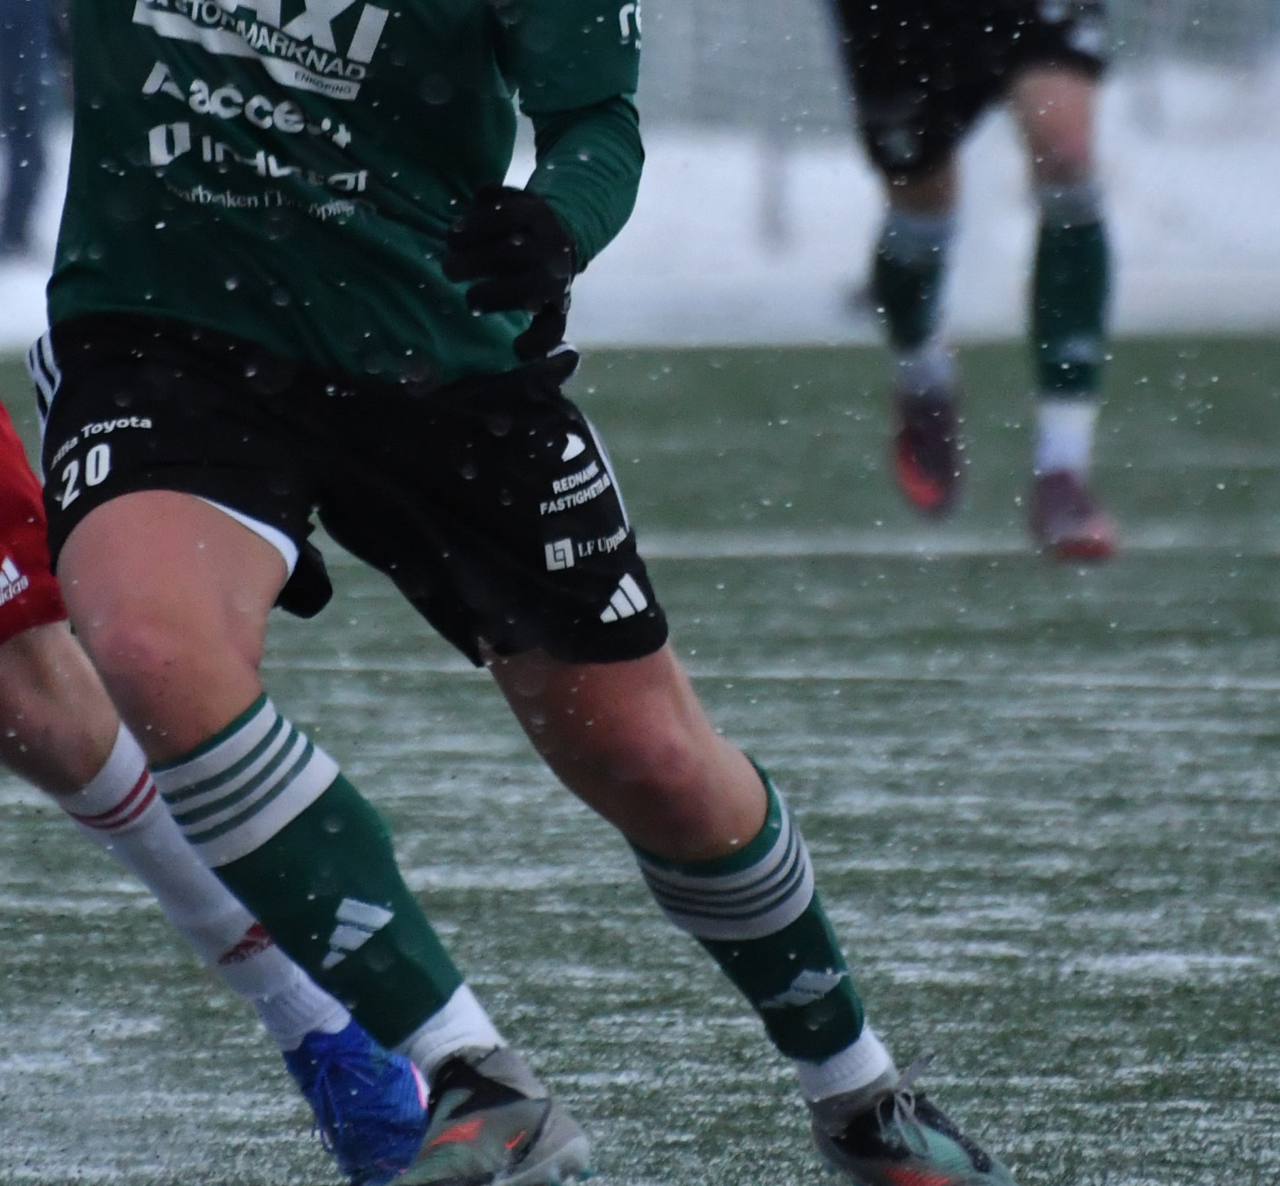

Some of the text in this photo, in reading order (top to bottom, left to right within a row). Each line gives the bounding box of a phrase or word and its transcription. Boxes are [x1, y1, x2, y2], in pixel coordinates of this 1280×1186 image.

[187, 77, 353, 149] accet
[80, 416, 153, 439] Toyota
[60, 442, 111, 511] 20
[577, 541, 595, 558] LF
